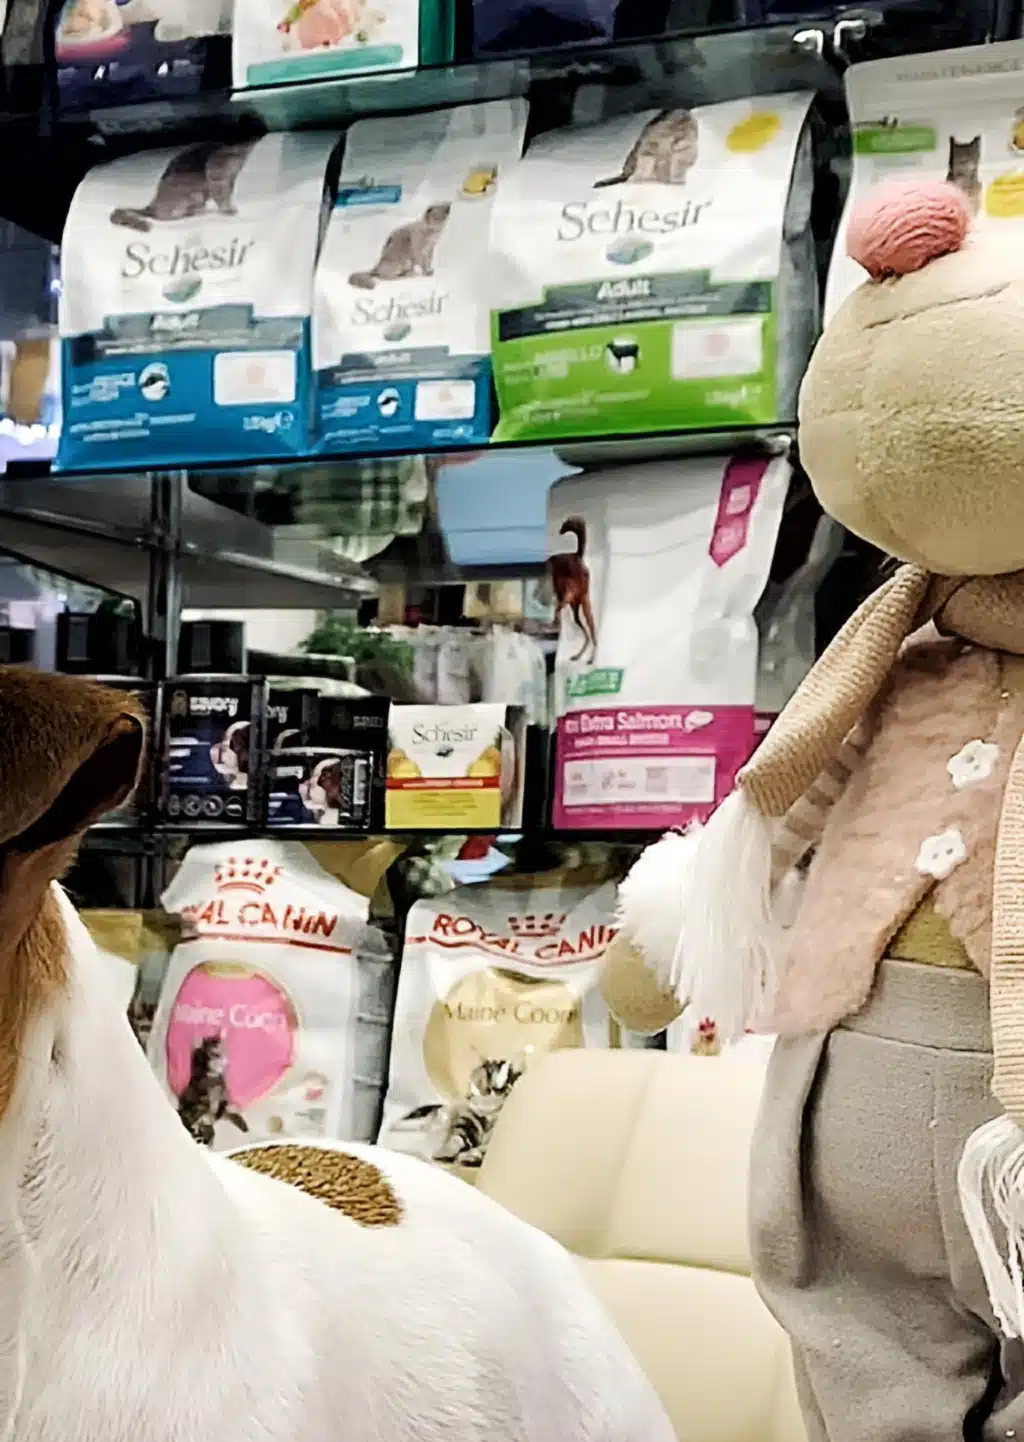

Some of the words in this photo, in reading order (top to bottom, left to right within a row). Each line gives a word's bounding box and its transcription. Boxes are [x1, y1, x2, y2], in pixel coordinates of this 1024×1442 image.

[556, 199, 714, 241] Schesir
[121, 237, 255, 279] Schesir
[598, 278, 652, 301] Adult
[352, 291, 450, 325] Schesir
[617, 711, 683, 731] Salmon
[432, 913, 521, 953] ROYAL
[444, 1002, 507, 1023] Maine
[513, 1000, 580, 1025] Coon
